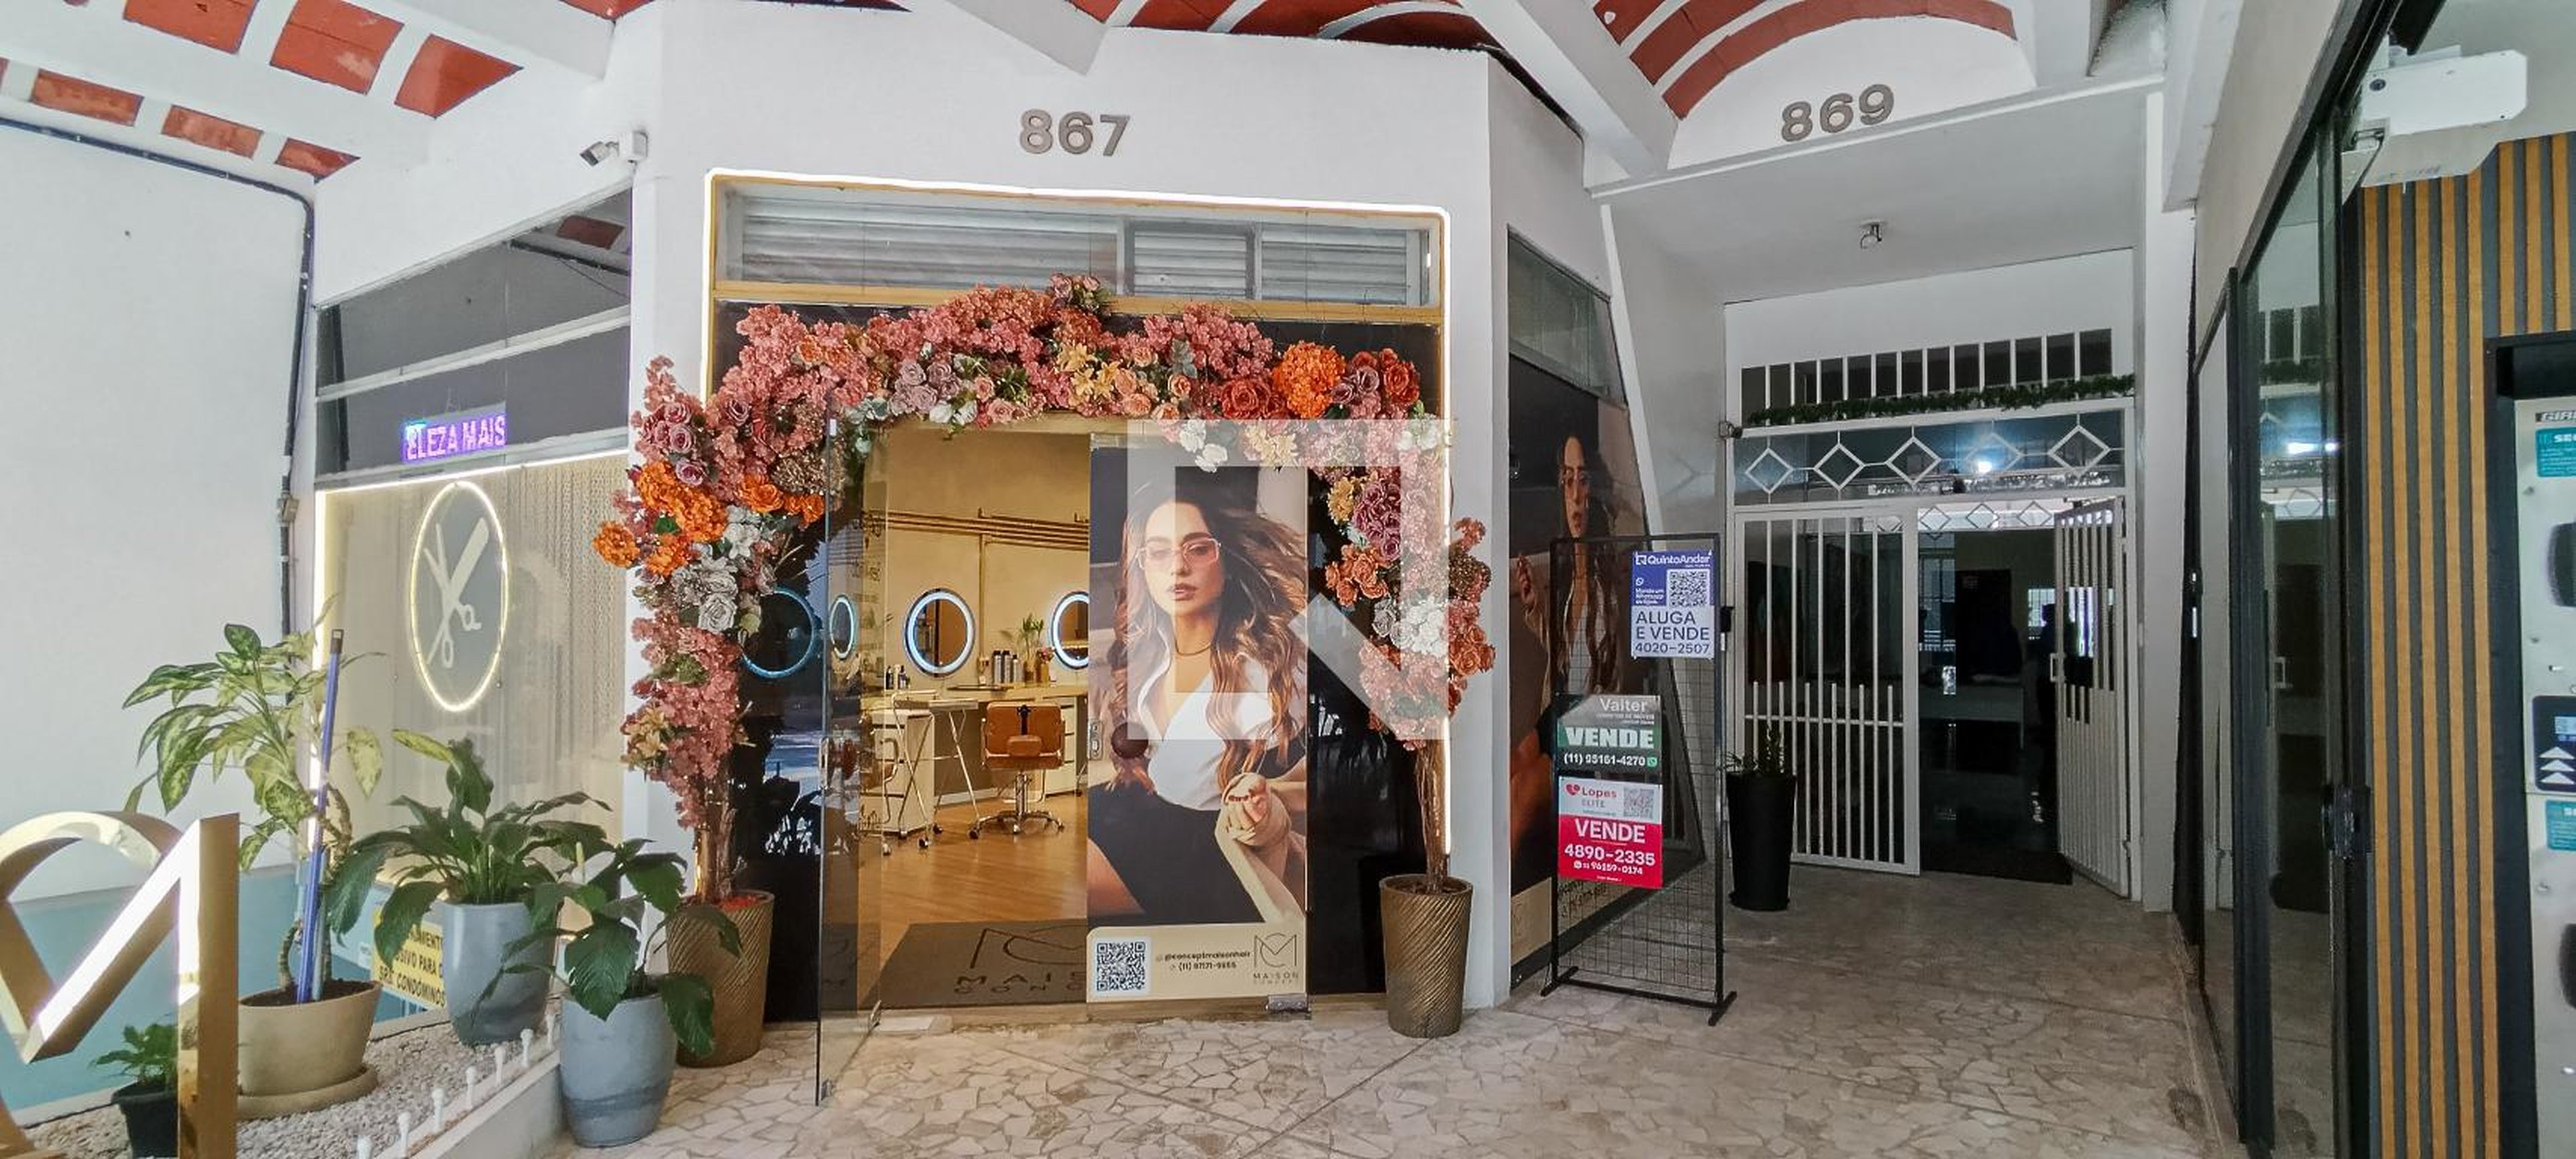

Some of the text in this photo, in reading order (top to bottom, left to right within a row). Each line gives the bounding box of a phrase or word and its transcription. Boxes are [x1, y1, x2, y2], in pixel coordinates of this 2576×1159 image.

[1781, 83, 1894, 142] 869
[1019, 108, 1131, 157] 867
[462, 415, 506, 451] MAIS
[1648, 553, 1711, 565] QuintoAndar
[1635, 610, 1696, 624] ALUGA
[1636, 626, 1710, 641] E VENDE
[1635, 642, 1710, 655] 4020-2507
[1564, 726, 1655, 749] VENDE
[1563, 752, 1584, 765] (11)
[1581, 787, 1618, 798] Lopes
[1574, 818, 1646, 844] VENDE
[1564, 843, 1656, 867] 4890-2335
